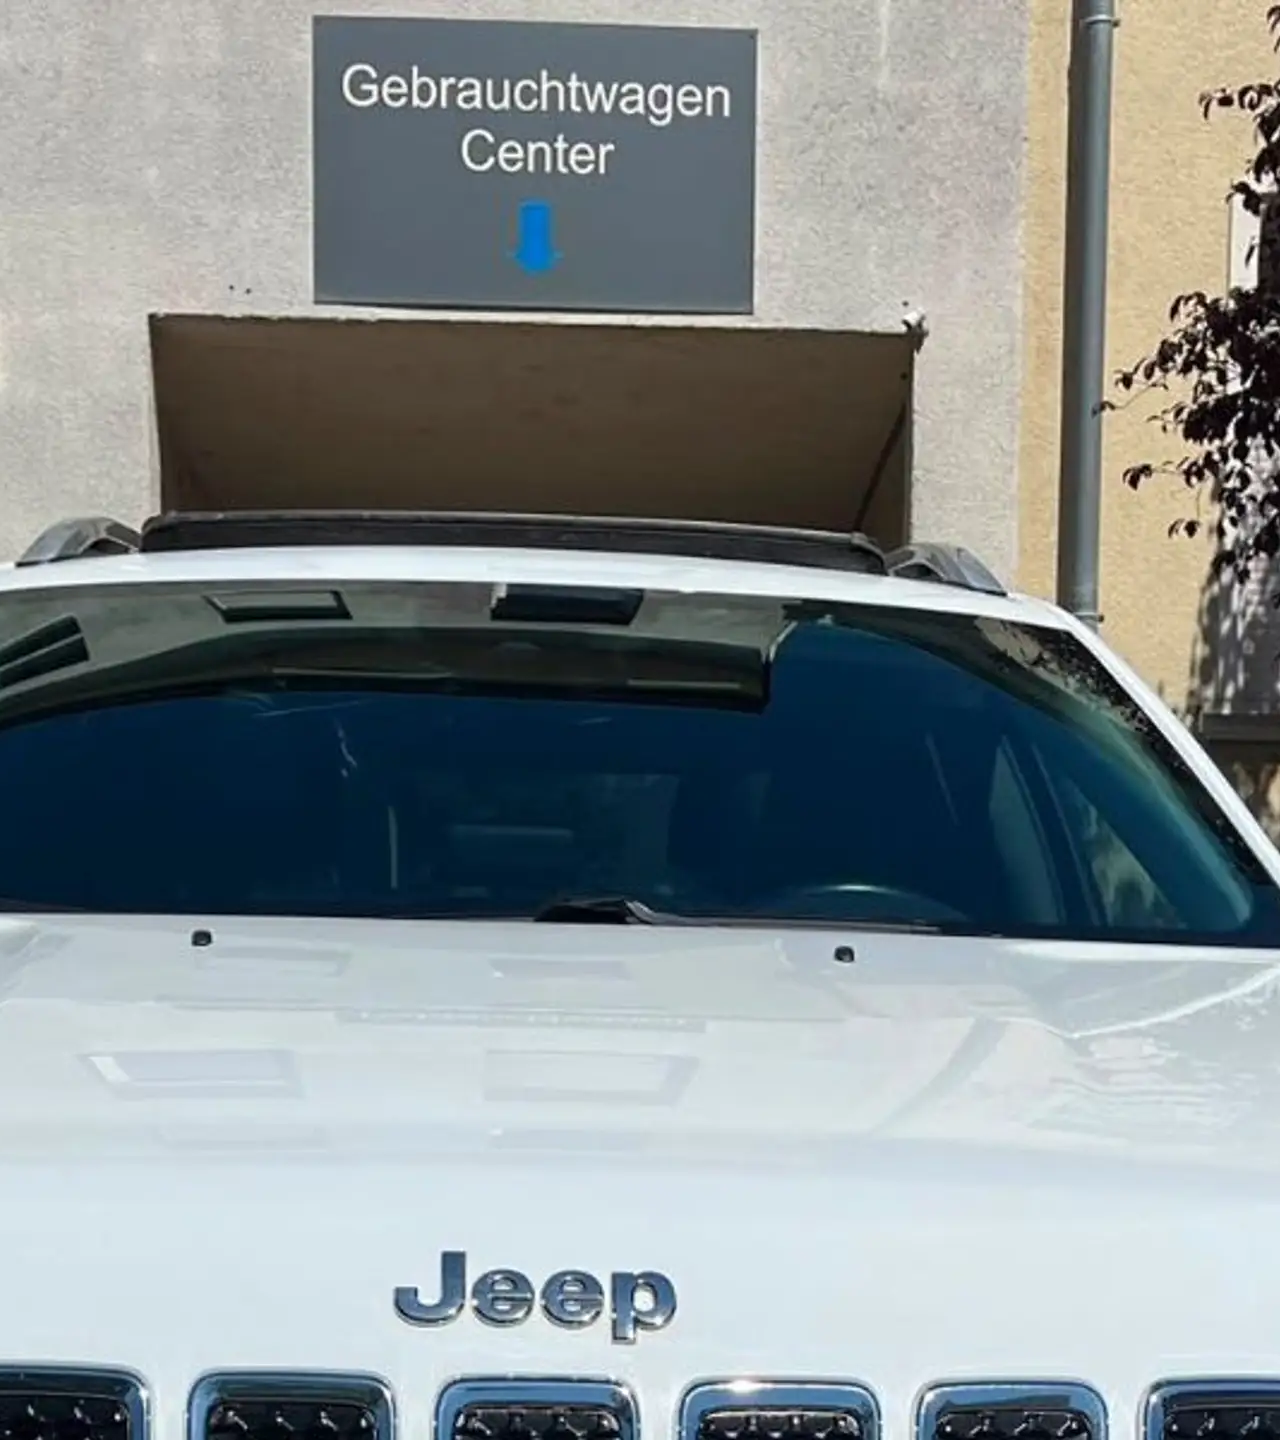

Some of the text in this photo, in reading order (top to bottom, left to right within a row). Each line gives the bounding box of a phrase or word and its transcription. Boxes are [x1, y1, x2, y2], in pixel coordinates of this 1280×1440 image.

[341, 62, 731, 126] Gebrauchtwagen
[460, 128, 615, 175] Center
[393, 1250, 678, 1345] Jeep
